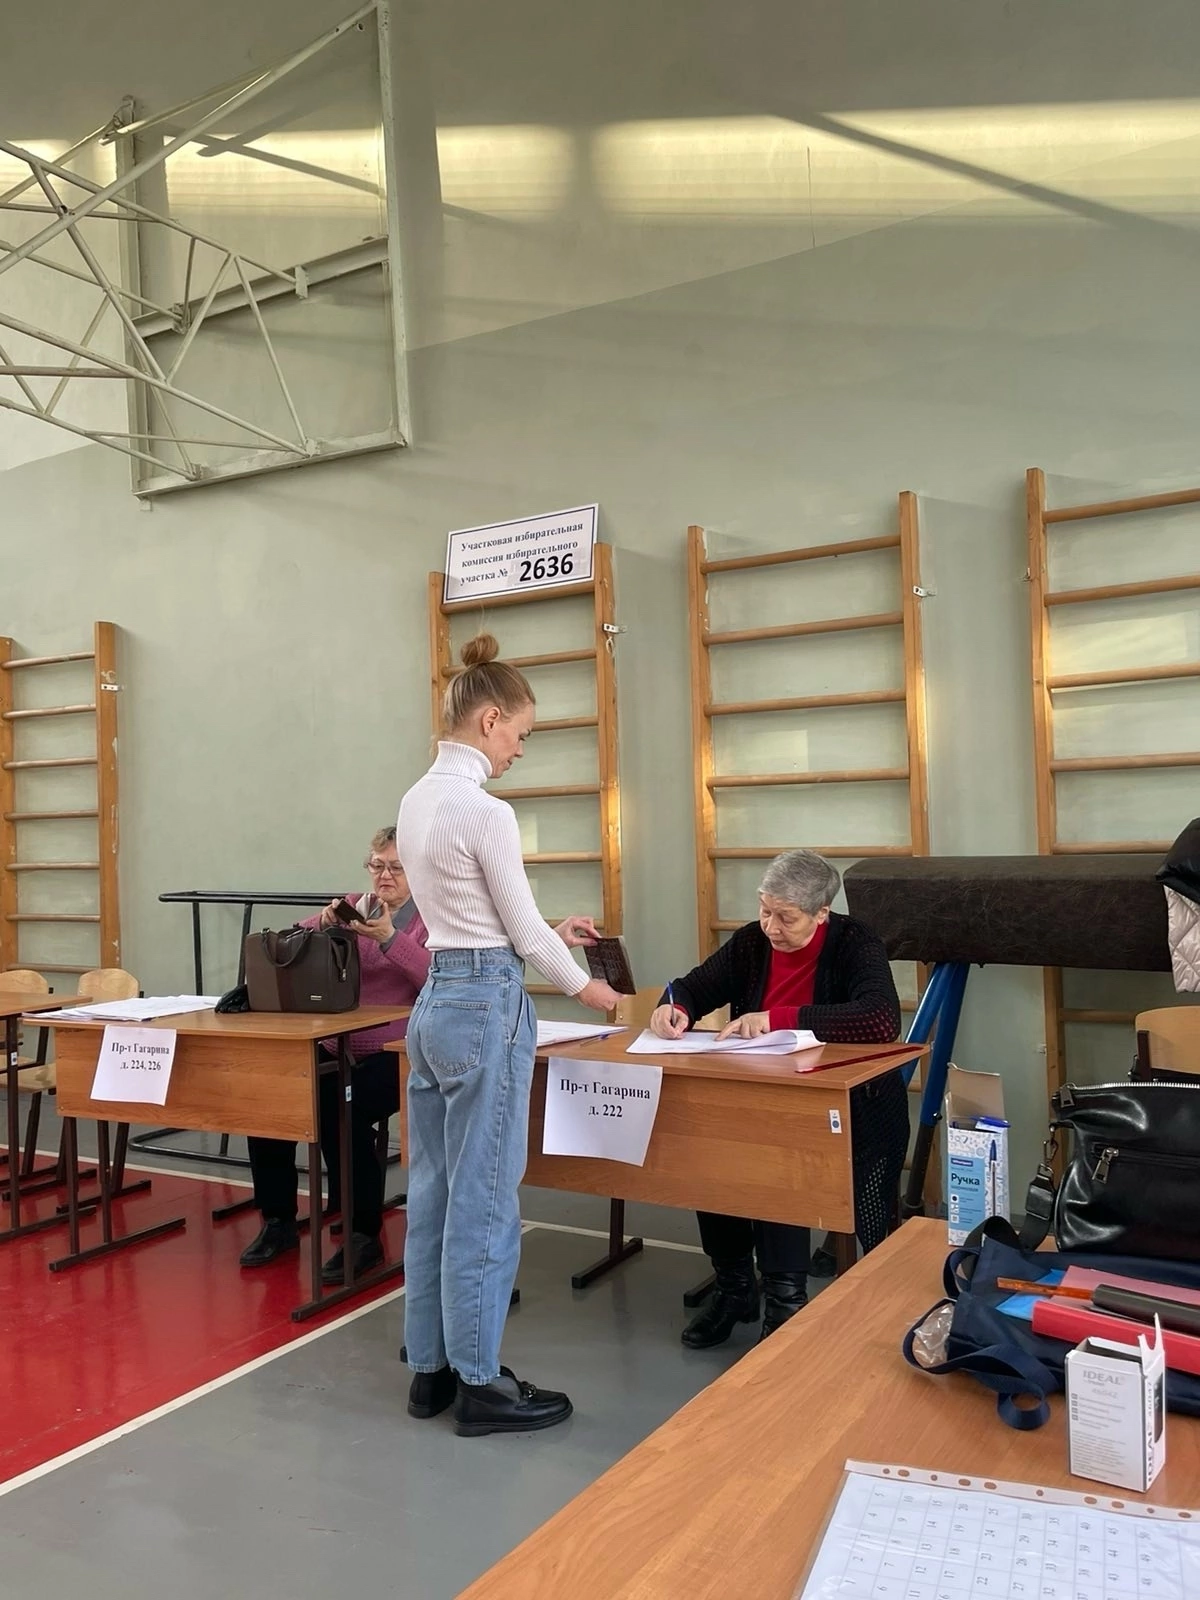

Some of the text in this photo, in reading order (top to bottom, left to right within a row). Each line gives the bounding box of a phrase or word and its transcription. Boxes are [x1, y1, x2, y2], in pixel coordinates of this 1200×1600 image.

[461, 523, 583, 552] Участковая избирательная
[462, 541, 578, 568] комиссия избирательного
[460, 552, 573, 586] участка № 2636
[111, 1042, 170, 1056] Пр-т Гагарина
[120, 1060, 162, 1071] д. 224, 226
[560, 1078, 651, 1100] Пр-т Гагарина
[588, 1103, 623, 1118] д. 222
[951, 1172, 980, 1186] Ручка
[1082, 1370, 1123, 1386] IDEAL
